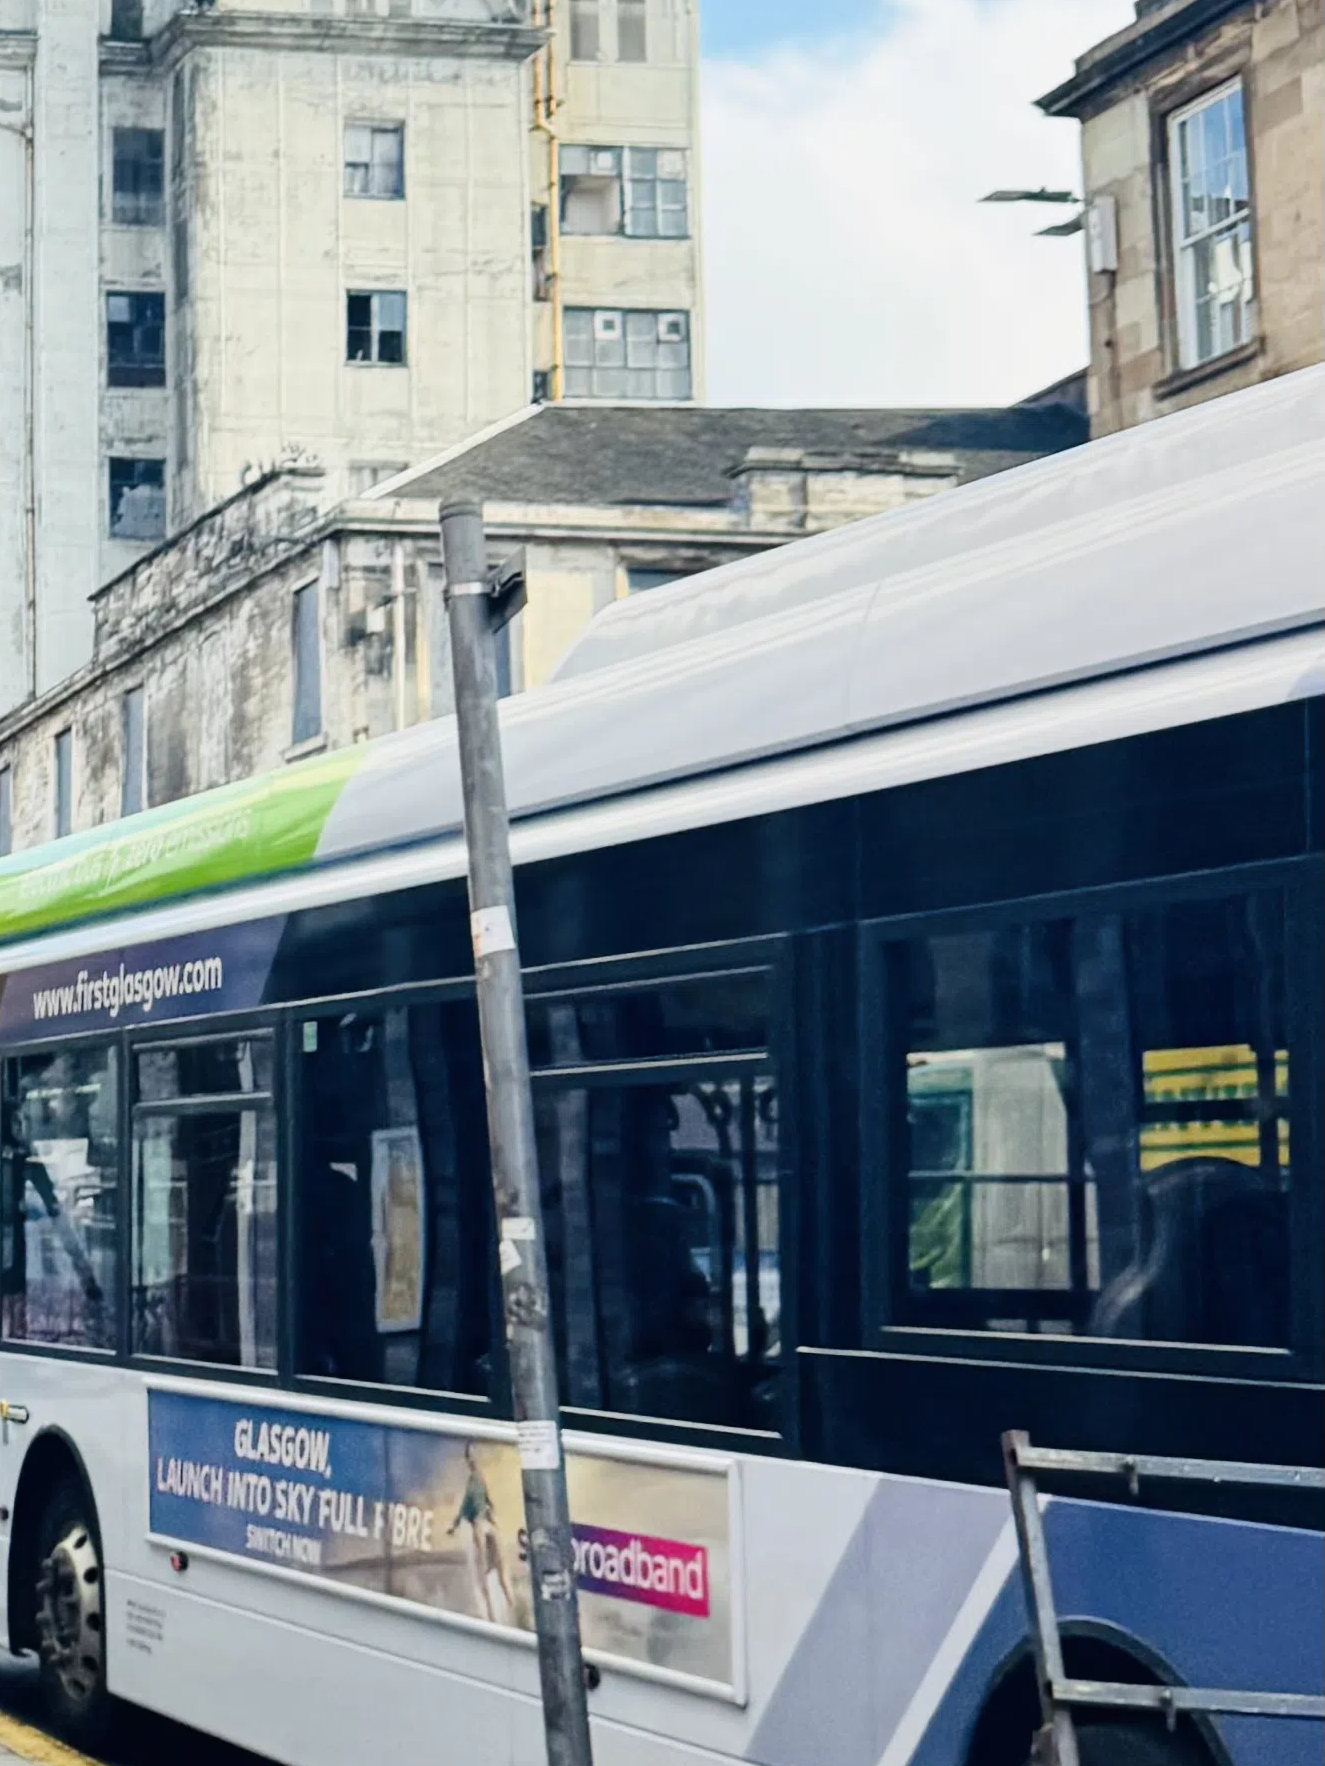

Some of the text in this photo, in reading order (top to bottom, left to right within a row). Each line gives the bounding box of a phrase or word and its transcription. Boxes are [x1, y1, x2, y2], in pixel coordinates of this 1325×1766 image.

[33, 956, 222, 1018] www.firstglasgow.com
[234, 1418, 331, 1480] GLASGOW,
[156, 1457, 223, 1506] LAUNCH
[227, 1470, 272, 1516] INTO
[275, 1480, 315, 1527] SKY
[319, 1489, 368, 1538] FULL
